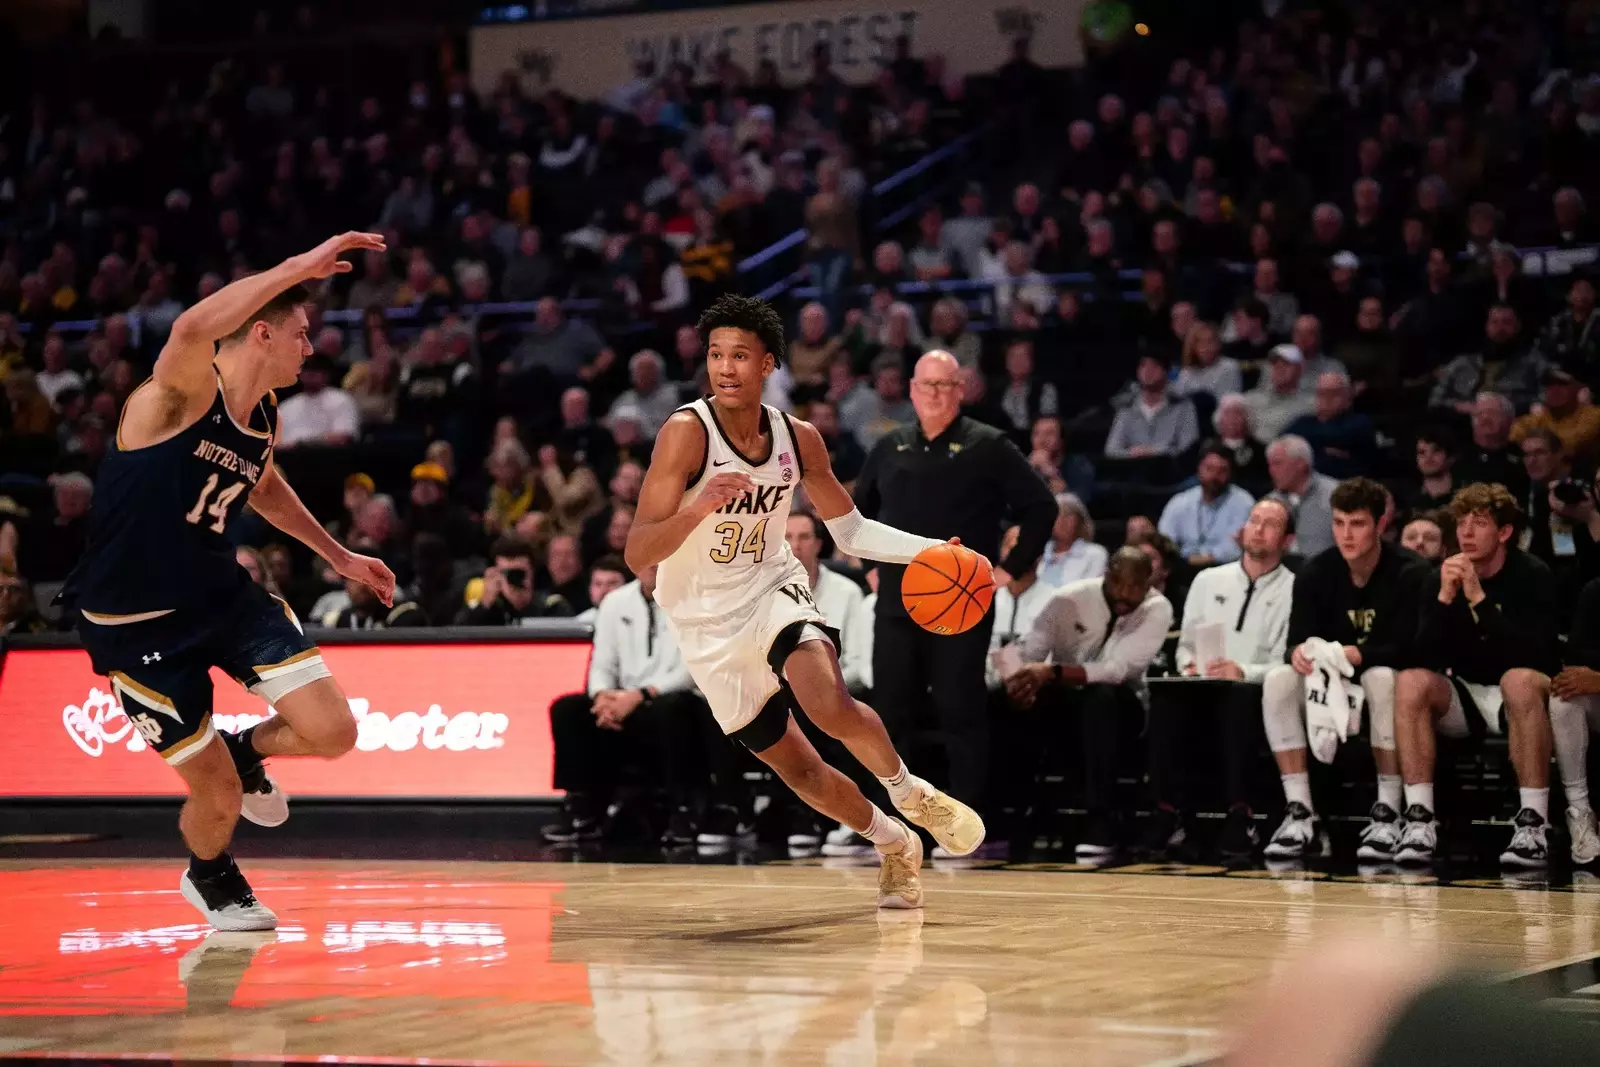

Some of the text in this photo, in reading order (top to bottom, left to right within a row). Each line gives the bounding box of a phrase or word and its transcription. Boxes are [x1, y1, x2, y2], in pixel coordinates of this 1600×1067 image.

[193, 440, 261, 484] NOTRE DE
[186, 473, 247, 534] 14
[710, 518, 770, 564] 34
